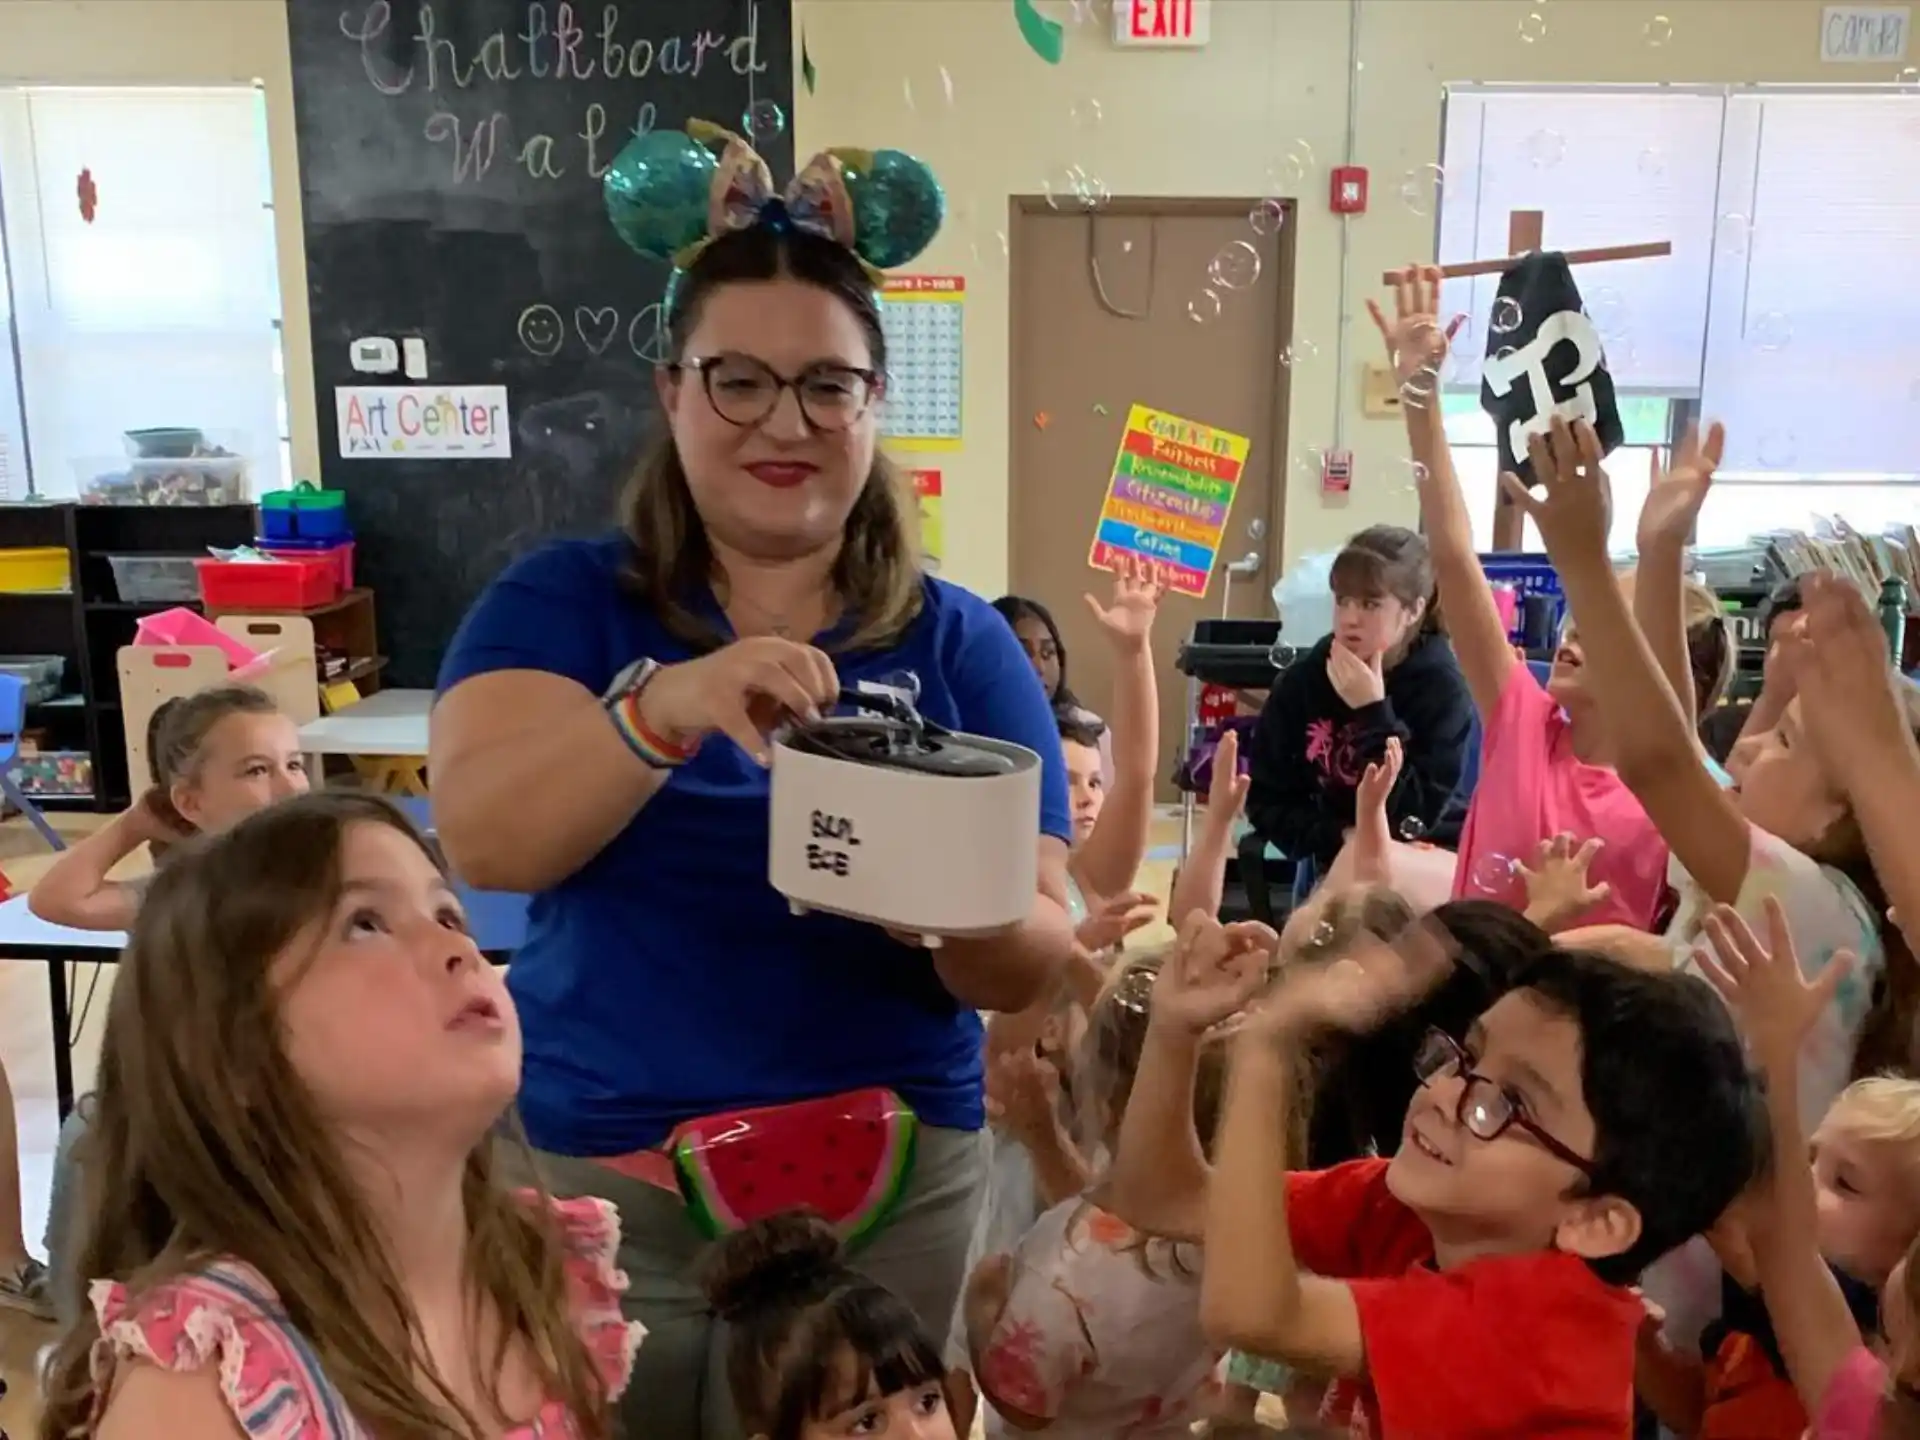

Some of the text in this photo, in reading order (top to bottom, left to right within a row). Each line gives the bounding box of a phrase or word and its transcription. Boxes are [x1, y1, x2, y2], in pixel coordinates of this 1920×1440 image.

[339, 0, 767, 94] Chalkboard
[347, 394, 500, 437] Art Center
